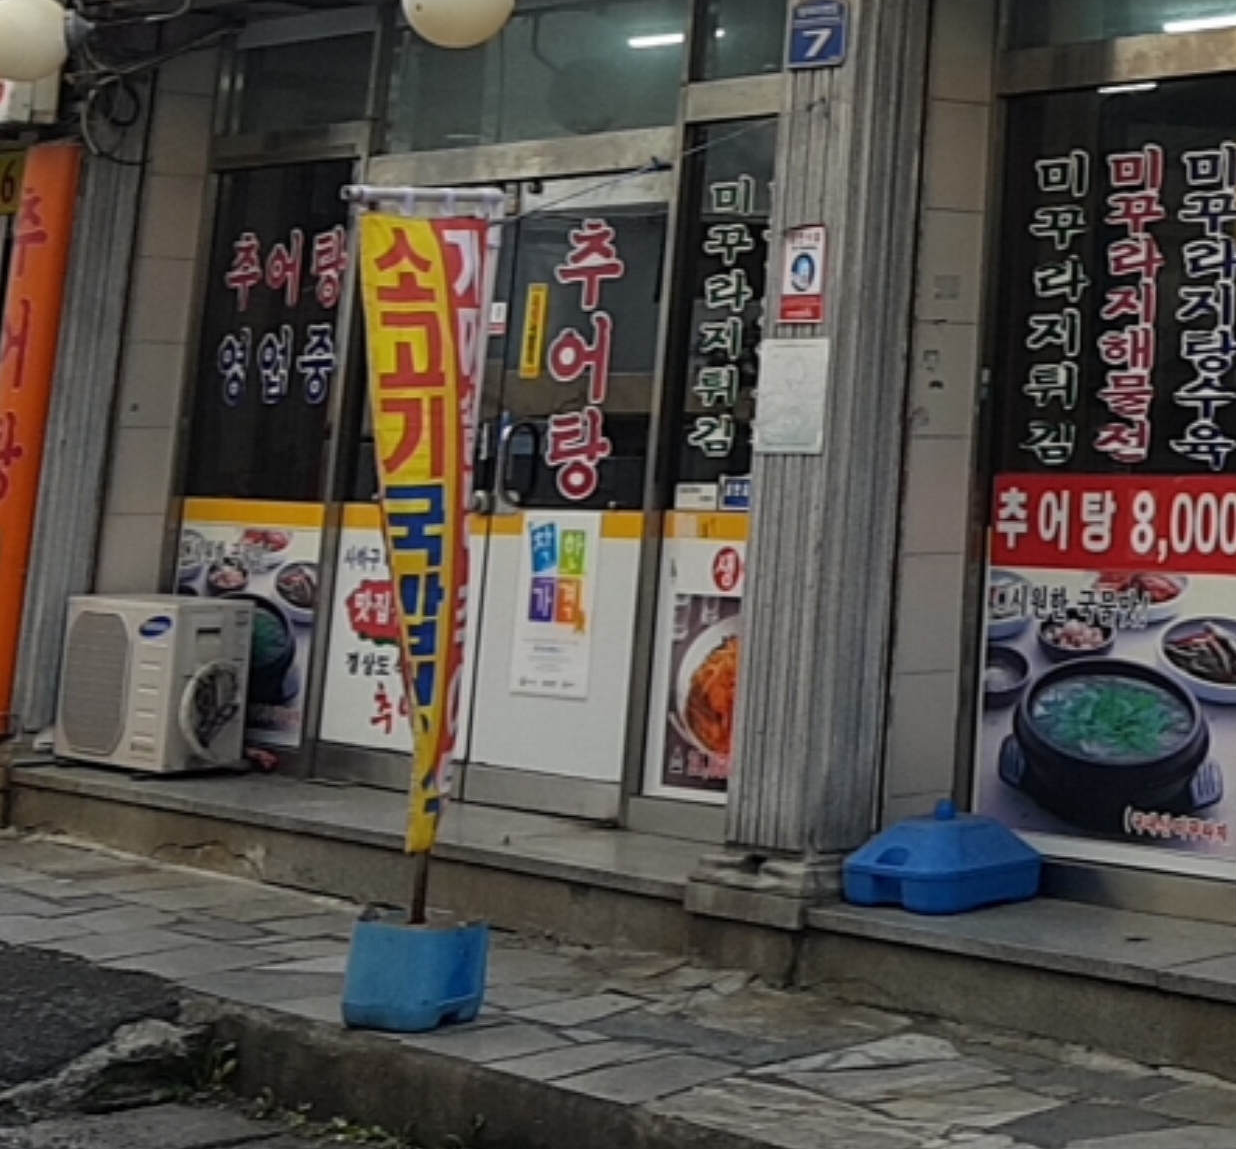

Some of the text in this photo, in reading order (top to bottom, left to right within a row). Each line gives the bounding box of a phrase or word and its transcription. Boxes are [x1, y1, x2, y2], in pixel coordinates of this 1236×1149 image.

[802, 27, 833, 59] 7
[225, 225, 347, 310] 추어탕
[1019, 149, 1091, 466] 미꾸라지튀김
[217, 322, 334, 407] 영업중
[546, 218, 624, 500] 추어탕
[996, 487, 1117, 552] 추어탕
